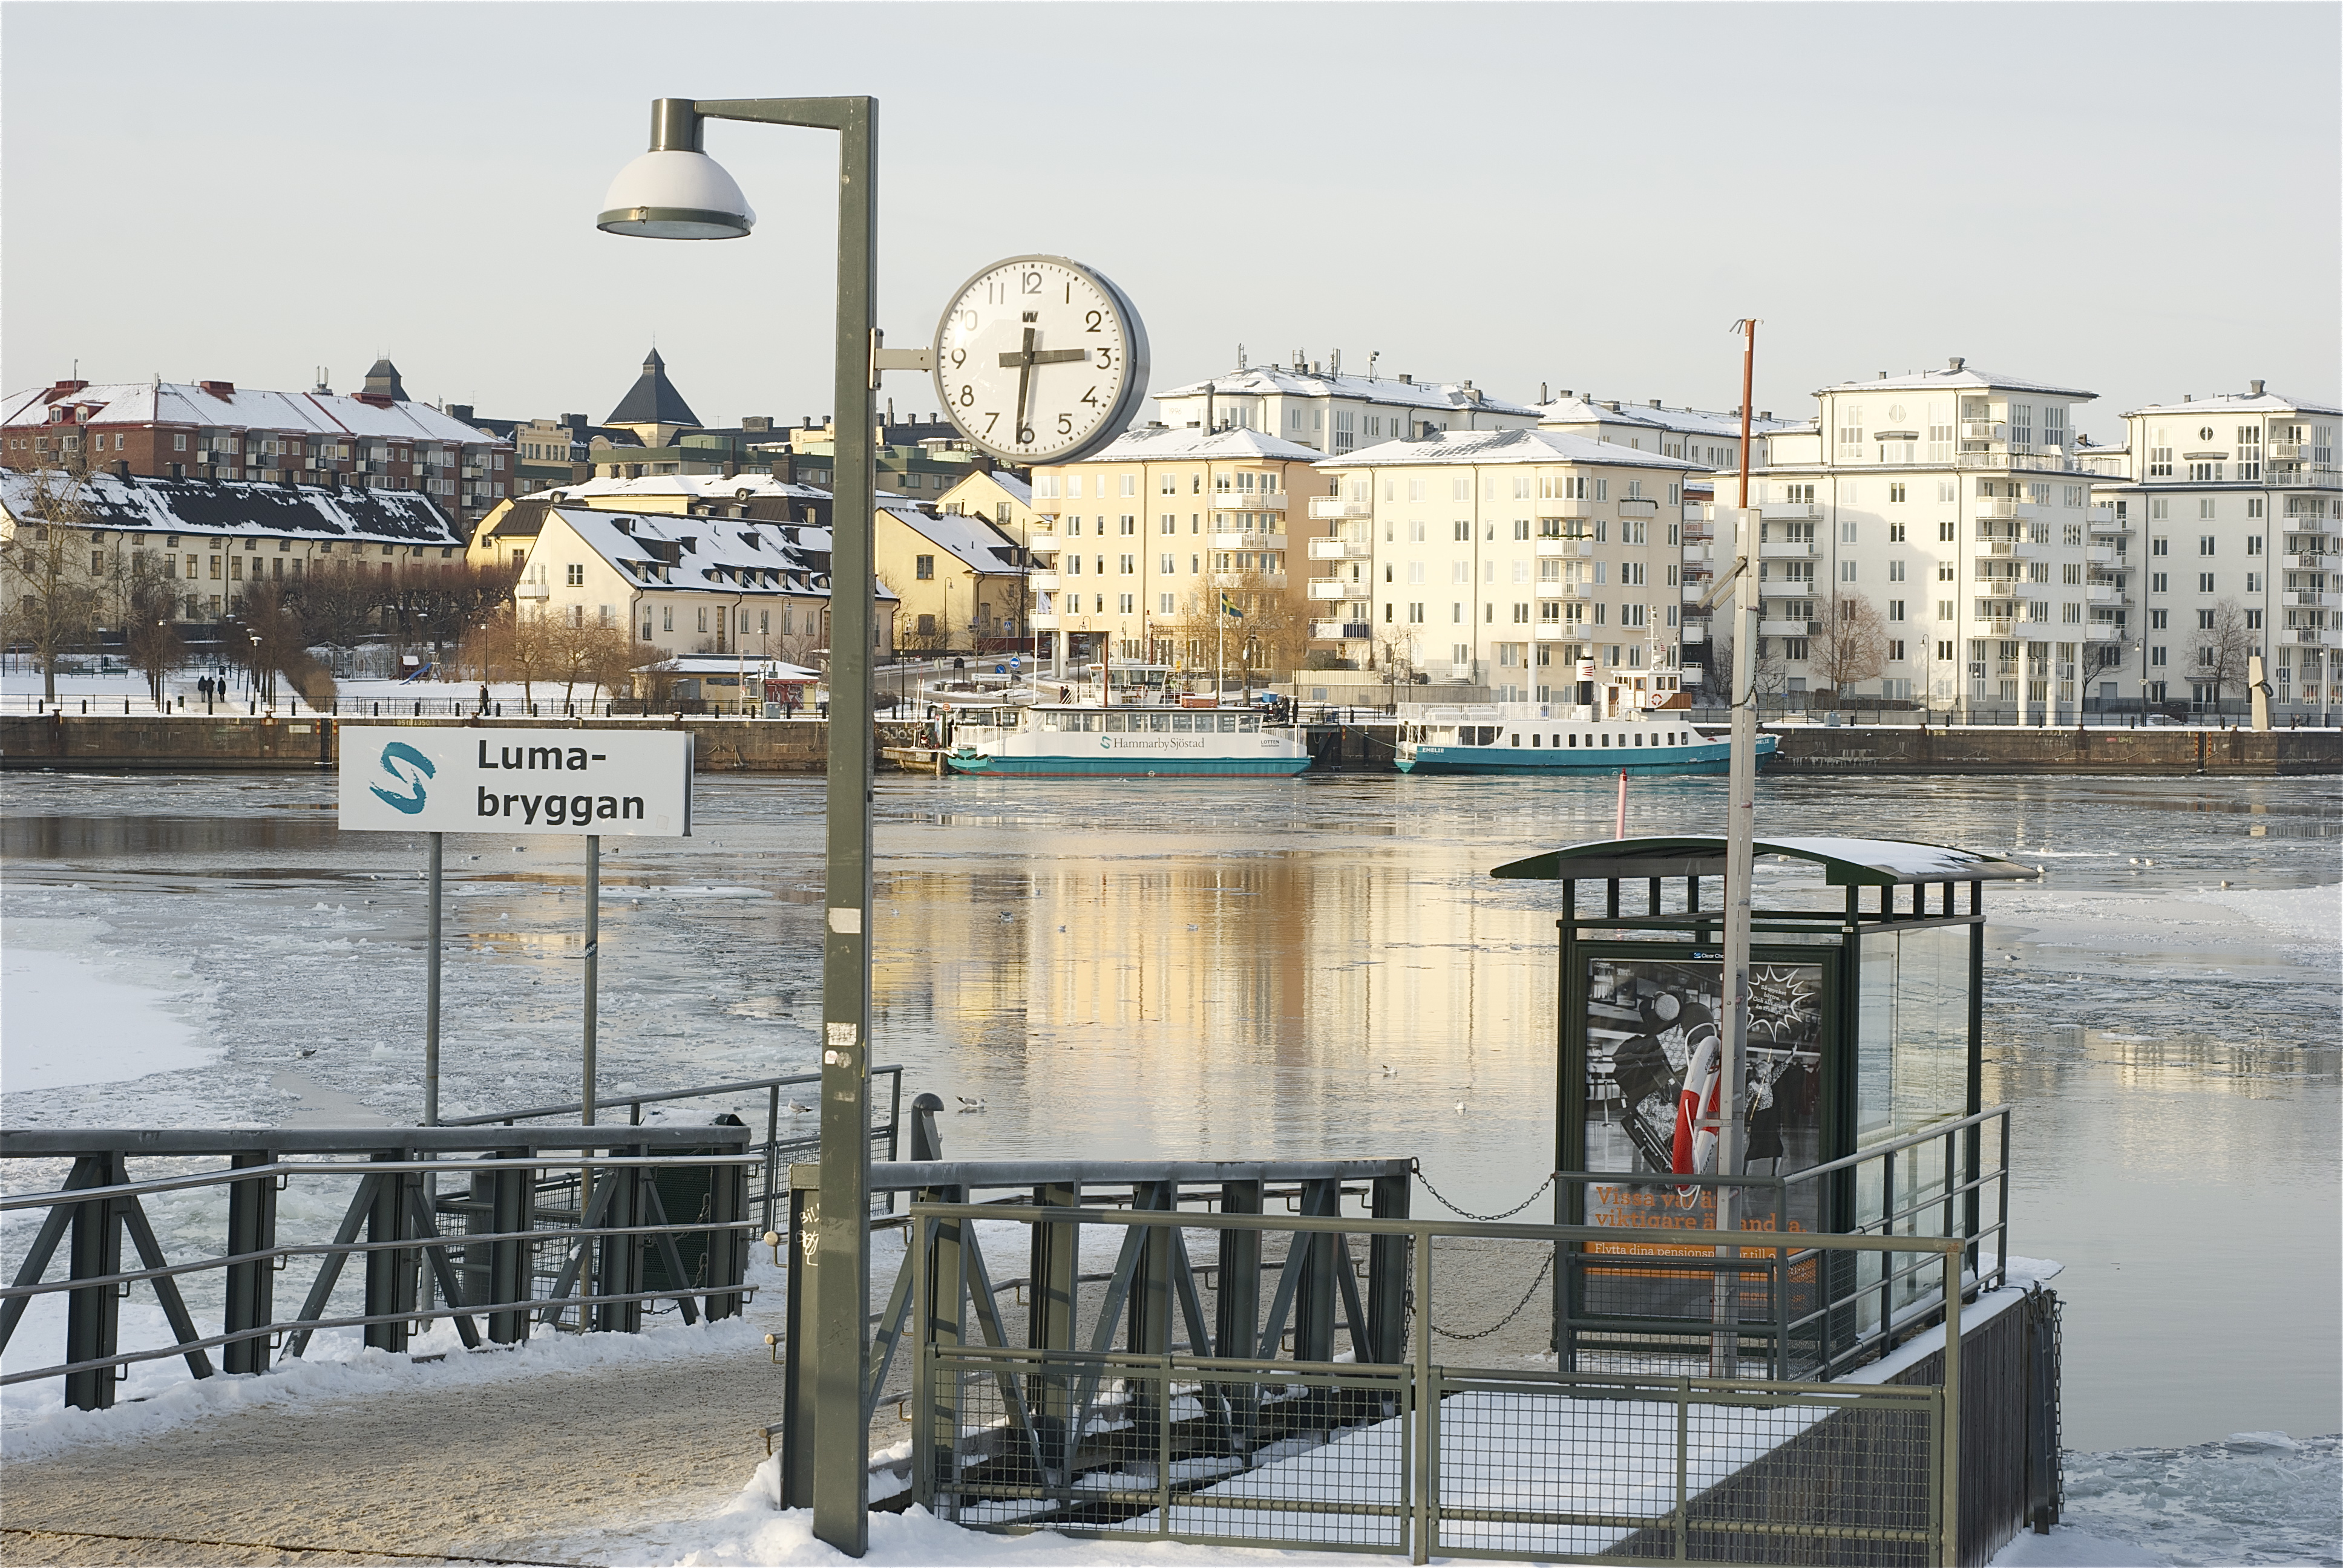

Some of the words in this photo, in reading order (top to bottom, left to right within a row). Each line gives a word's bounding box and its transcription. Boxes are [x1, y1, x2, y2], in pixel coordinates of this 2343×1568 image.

[989, 283, 1004, 304] 11
[1022, 272, 1042, 294] 12
[1066, 282, 1070, 304] 1
[960, 309, 978, 331] 10
[1086, 310, 1101, 332] 2
[951, 348, 966, 369] 9
[1096, 348, 1111, 370] 3
[960, 385, 974, 407] 8
[1080, 386, 1098, 408] 4
[985, 413, 1000, 433] 7
[1057, 413, 1072, 435] 5
[479, 739, 606, 770] Luma-
[1113, 737, 1169, 751] Hammarby
[1170, 737, 1204, 750] Sjöstad
[477, 786, 644, 826] bryggan
[1764, 998, 1773, 1007] allt
[1768, 987, 1787, 996] mycket
[1596, 1186, 1656, 1207] Vissa
[1701, 1191, 1716, 1209] ä
[1595, 1207, 1697, 1230] viktigare
[1594, 1243, 1627, 1255] Flytta
[1630, 1244, 1654, 1256] dina
[1750, 1248, 1766, 1258] till
